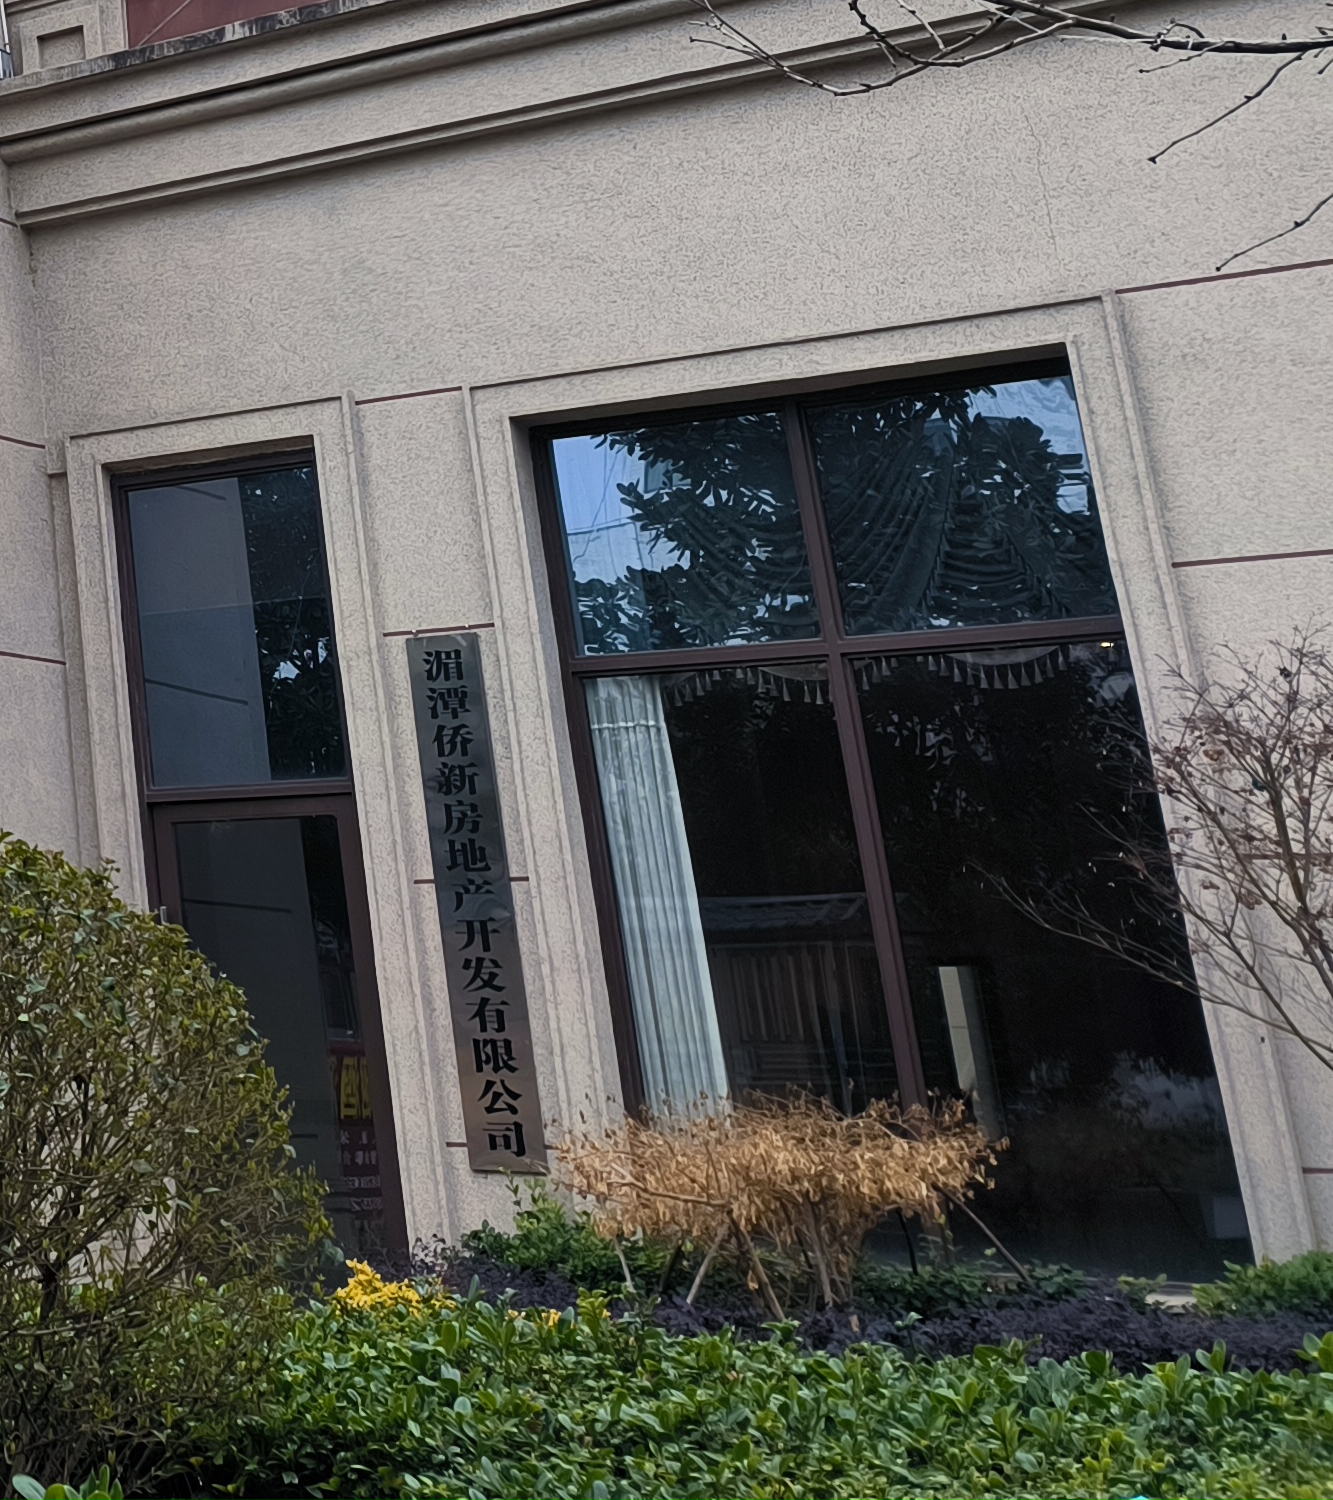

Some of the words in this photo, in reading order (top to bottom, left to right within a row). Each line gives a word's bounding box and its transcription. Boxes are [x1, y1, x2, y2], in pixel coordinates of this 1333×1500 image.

[422, 647, 527, 1159] 湄潭侨新房地产开发有限公司
